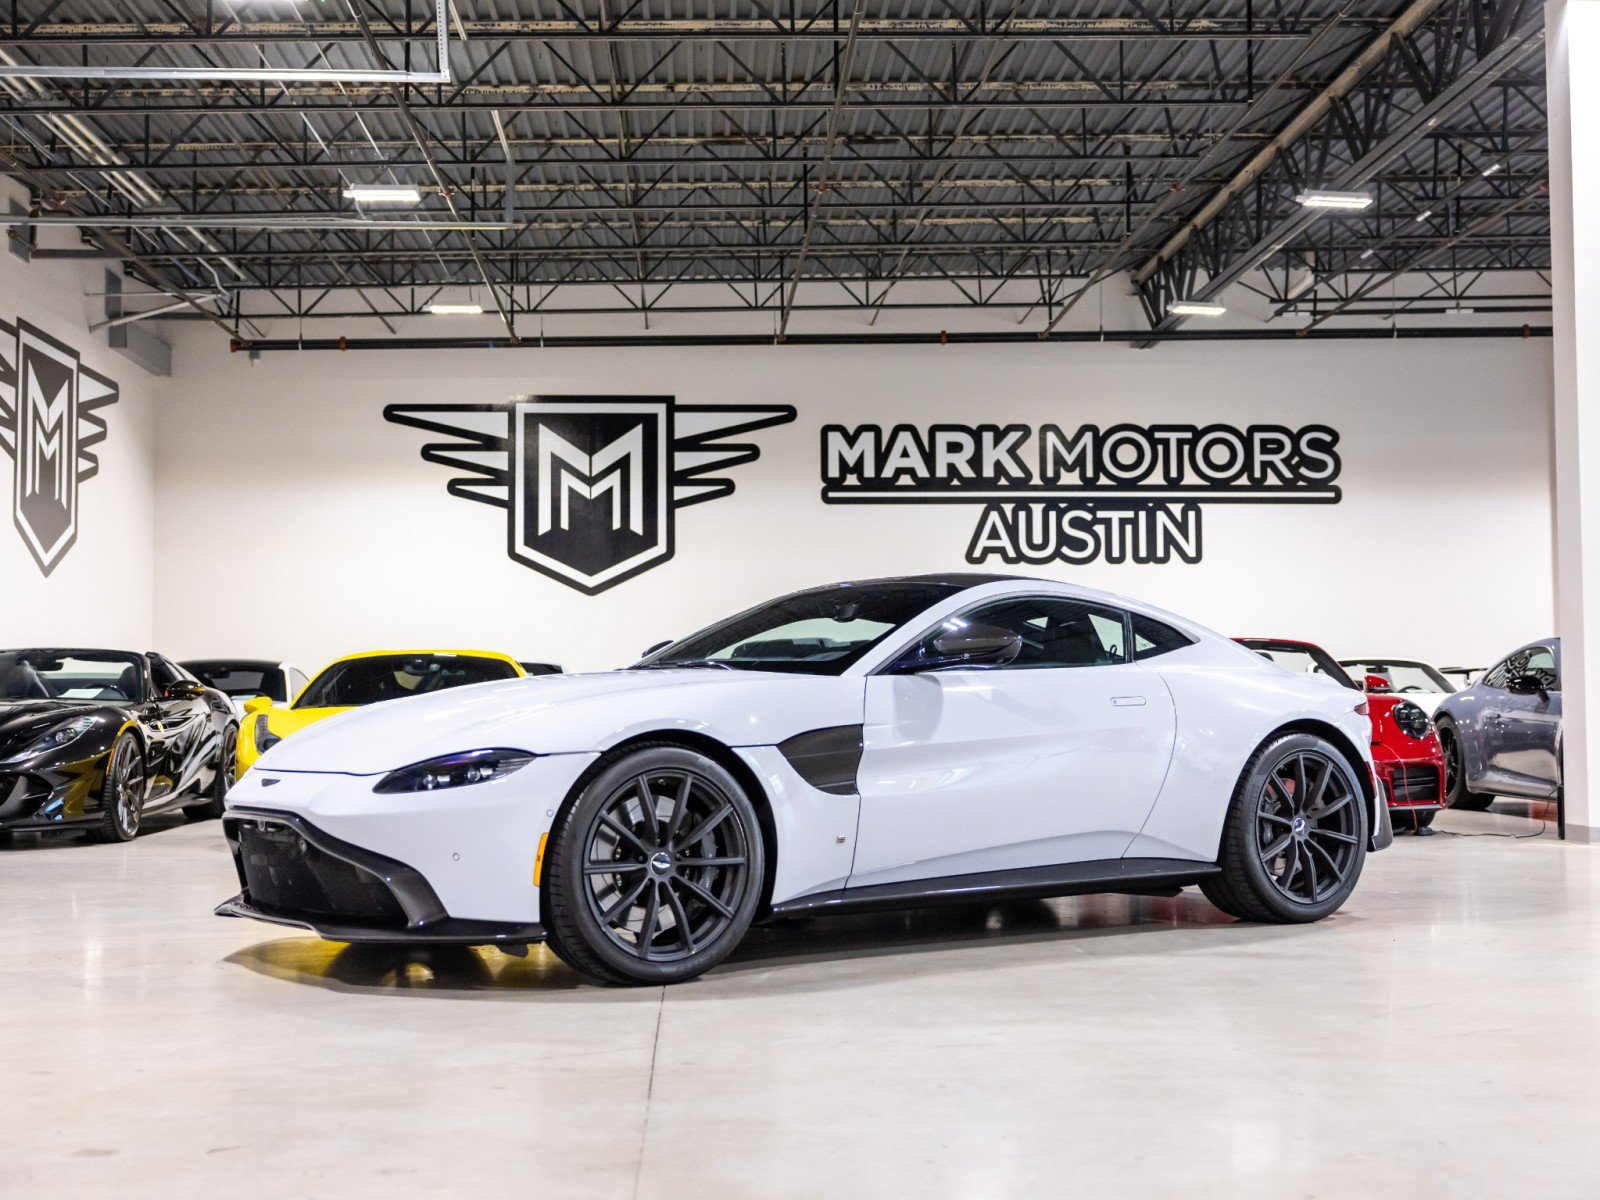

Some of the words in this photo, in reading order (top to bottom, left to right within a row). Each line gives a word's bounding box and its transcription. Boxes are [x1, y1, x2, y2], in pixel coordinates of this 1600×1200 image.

[826, 430, 1026, 478] MARK
[1046, 430, 1335, 479] MOTORS
[972, 510, 1196, 559] AUSTIN
